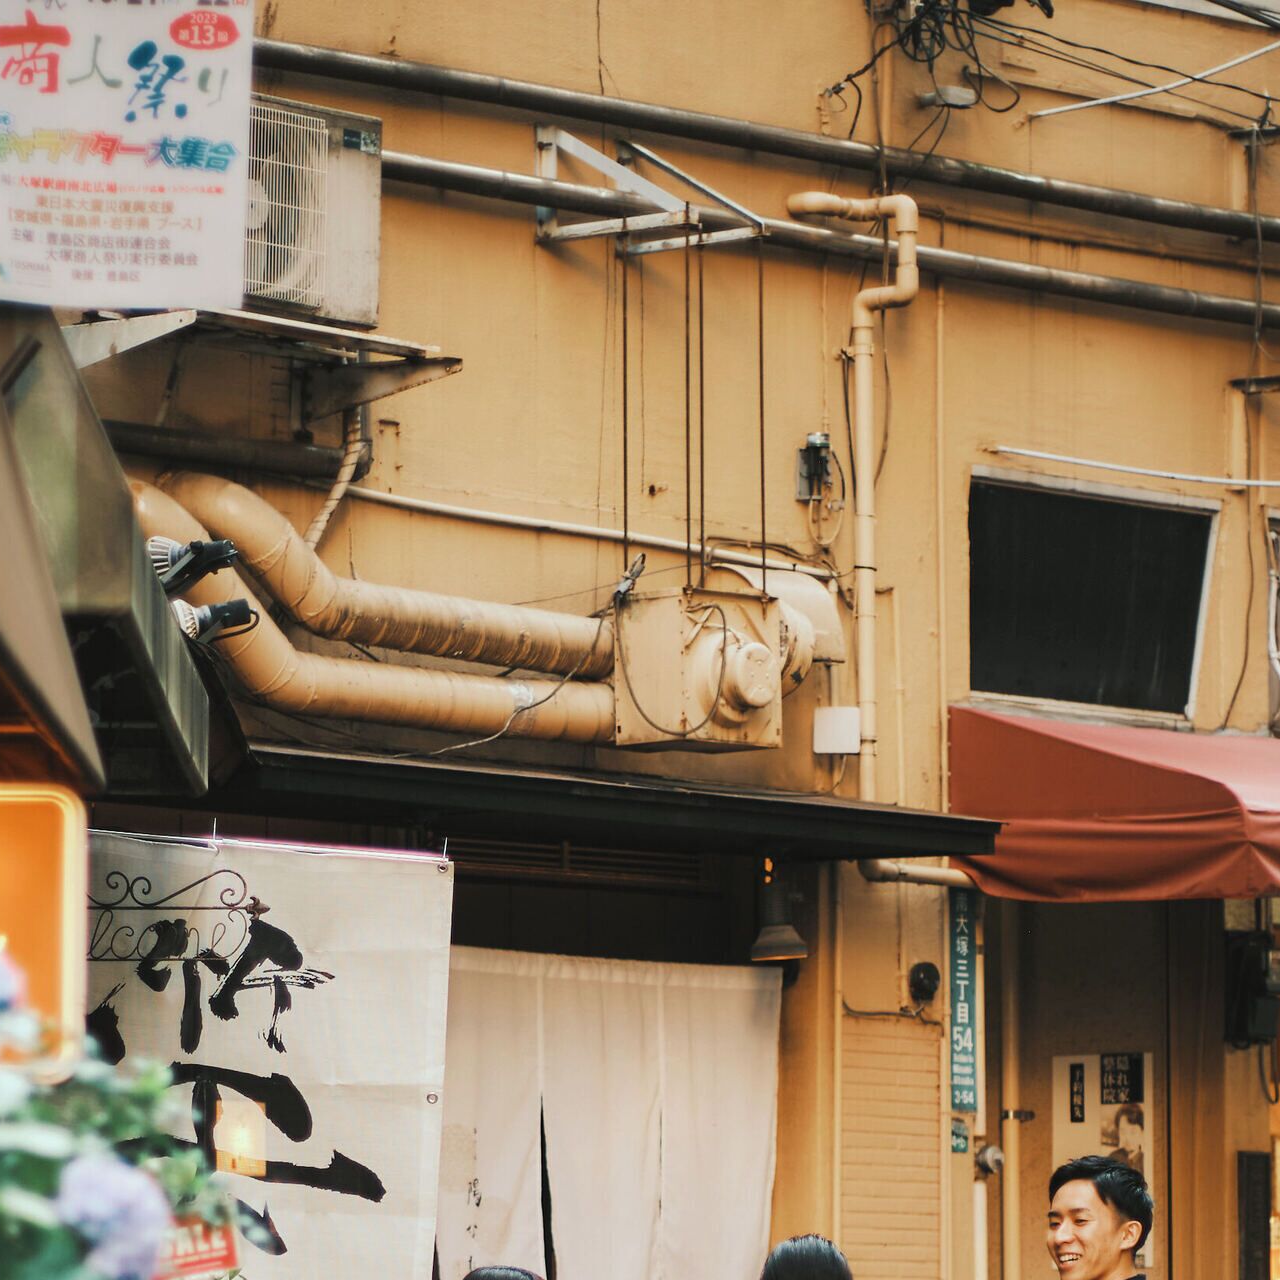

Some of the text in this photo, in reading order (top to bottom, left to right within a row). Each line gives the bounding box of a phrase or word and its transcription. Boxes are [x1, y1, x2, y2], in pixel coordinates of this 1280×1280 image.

[190, 13, 218, 24] 2023
[955, 892, 970, 1024] 南大塚三丁目
[951, 1025, 974, 1053] 54
